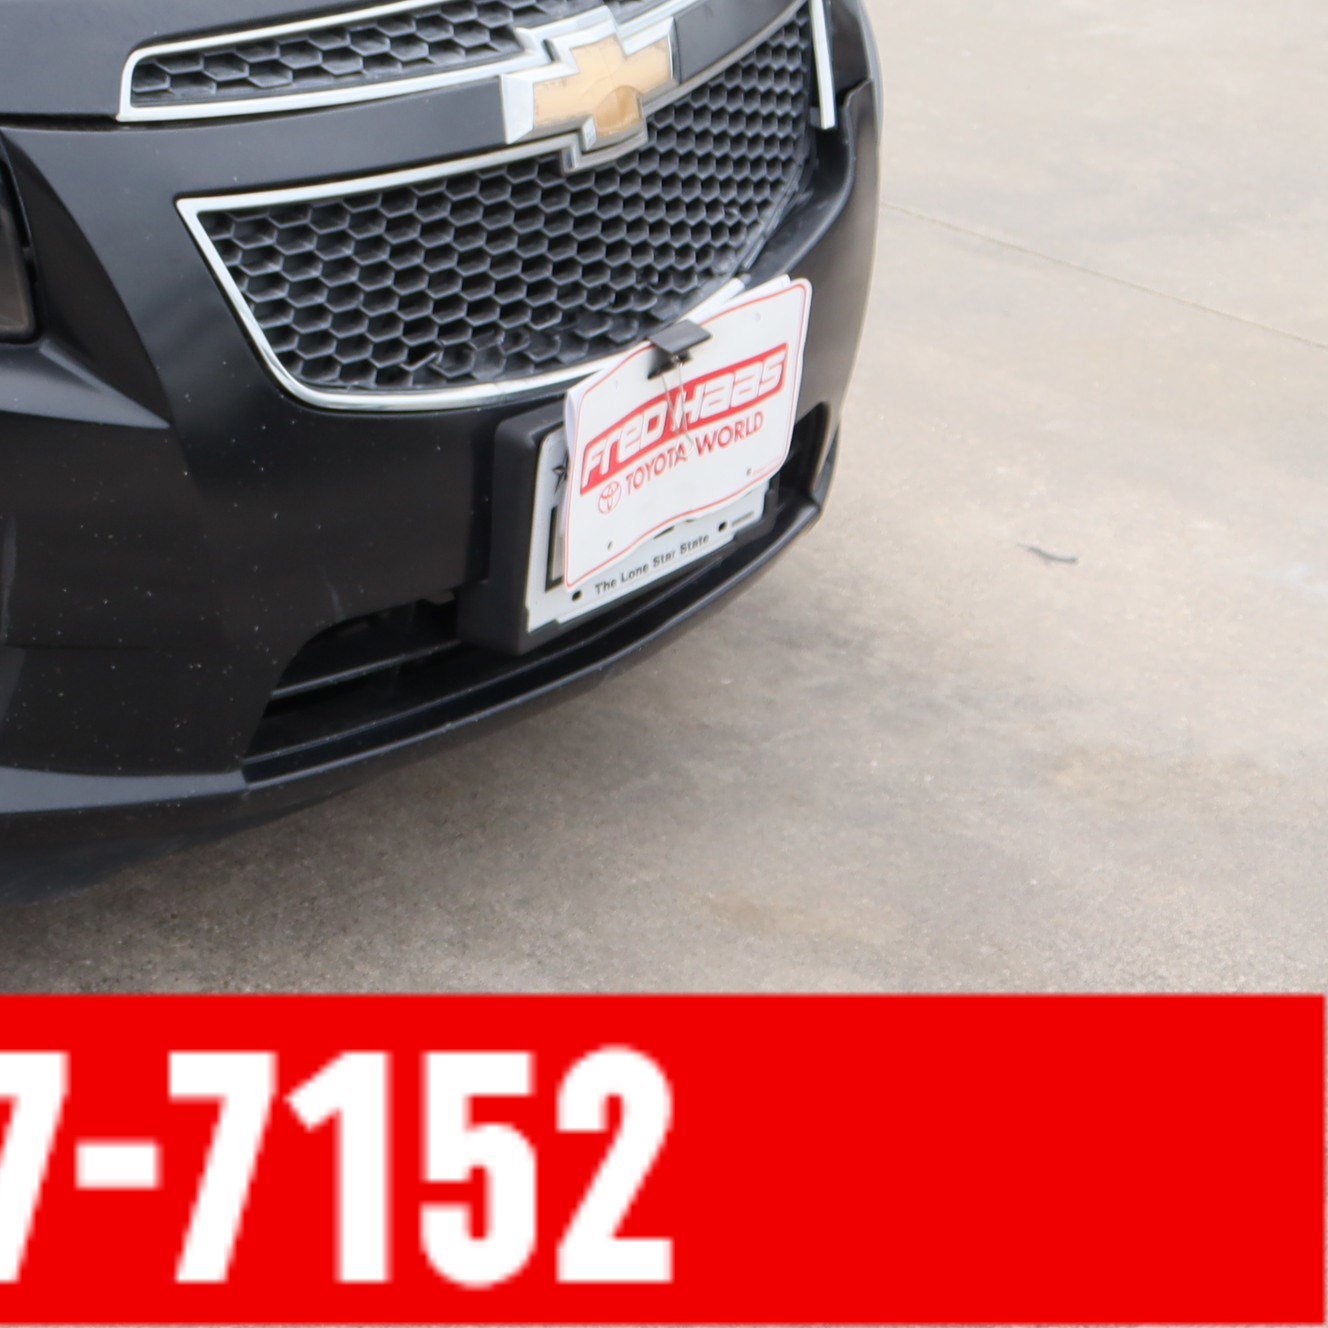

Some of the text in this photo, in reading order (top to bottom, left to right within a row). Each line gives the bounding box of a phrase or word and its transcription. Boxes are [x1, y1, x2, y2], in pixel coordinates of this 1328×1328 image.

[626, 411, 764, 496] TOYOTA WORLD
[595, 535, 709, 594] The Lone Star State
